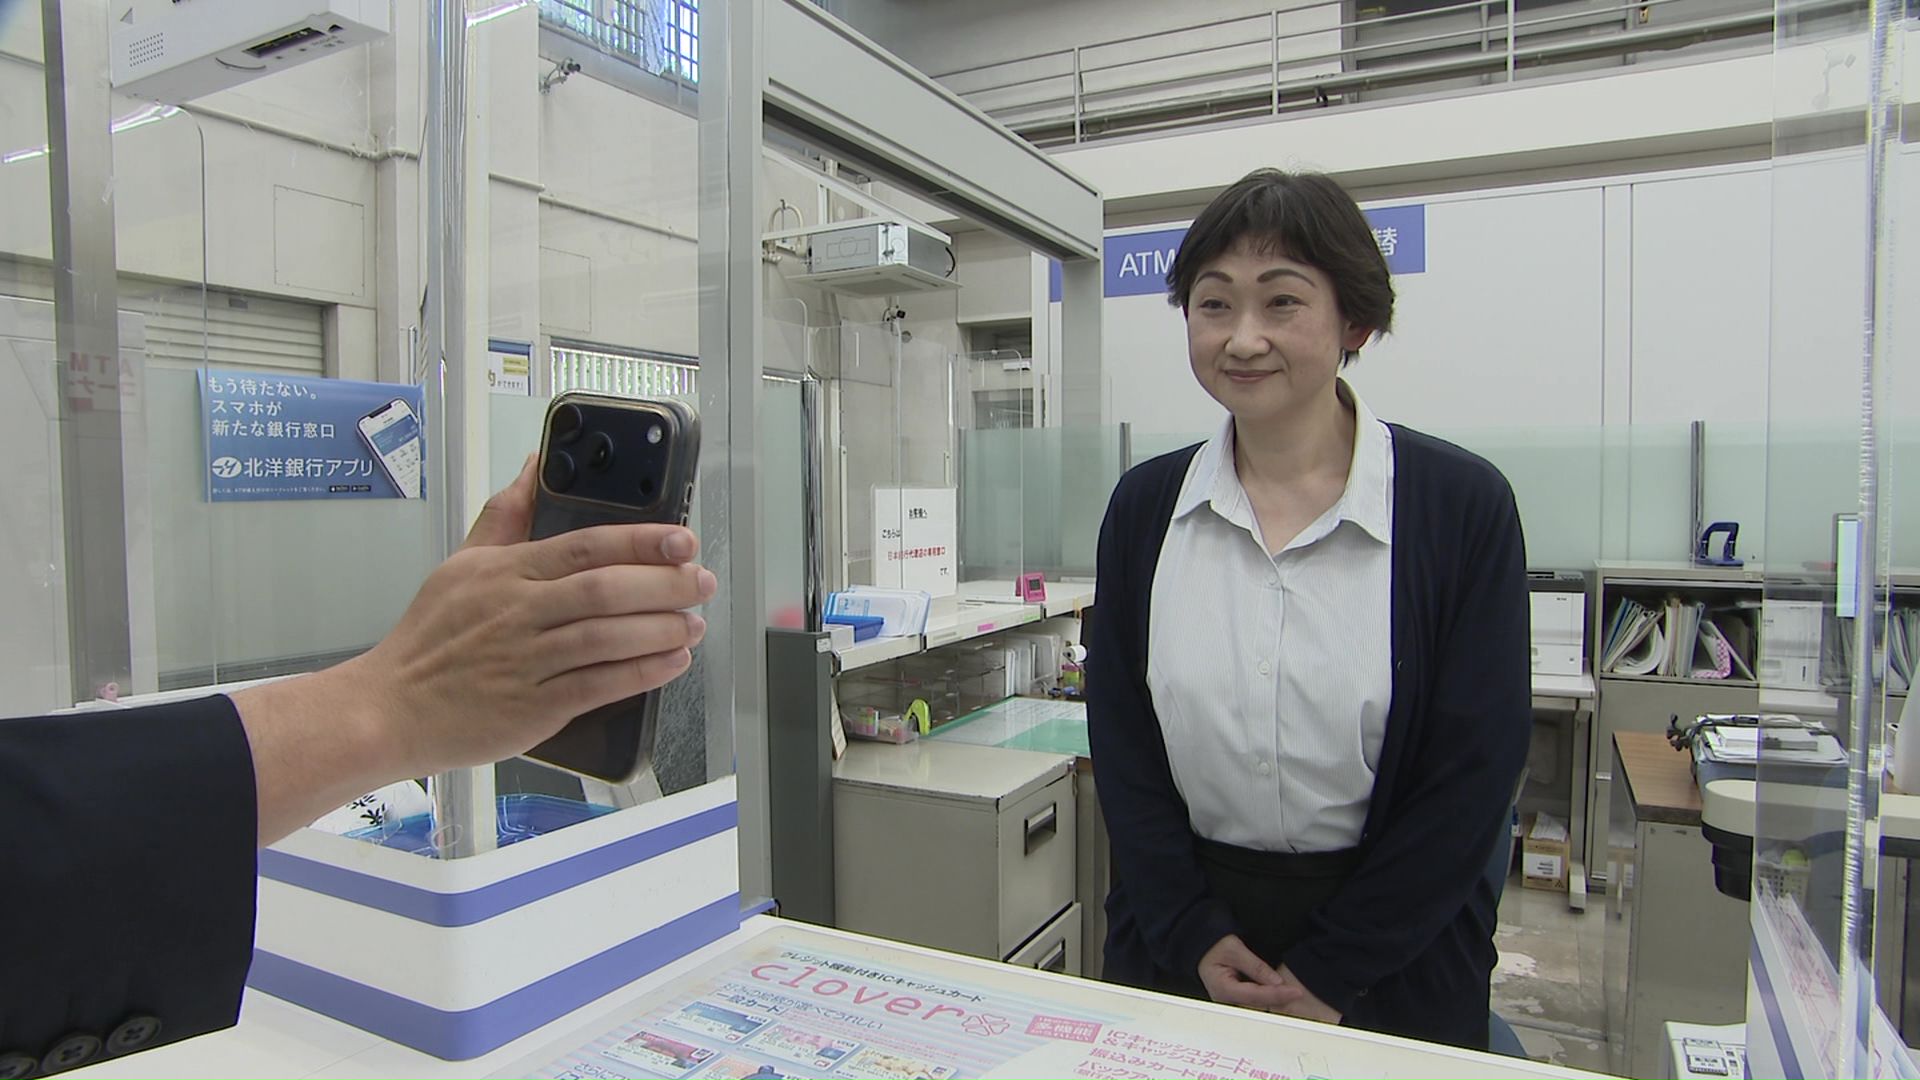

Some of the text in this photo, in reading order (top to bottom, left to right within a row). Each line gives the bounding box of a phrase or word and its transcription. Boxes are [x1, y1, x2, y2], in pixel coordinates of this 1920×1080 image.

[1119, 248, 1176, 278] ATM
[208, 376, 317, 400] もう待たない。
[212, 400, 282, 417] スマホが
[211, 419, 336, 440] 新たな銀行窓口
[243, 457, 374, 478] 北洋銀行アプリ
[750, 963, 965, 1020] clover
